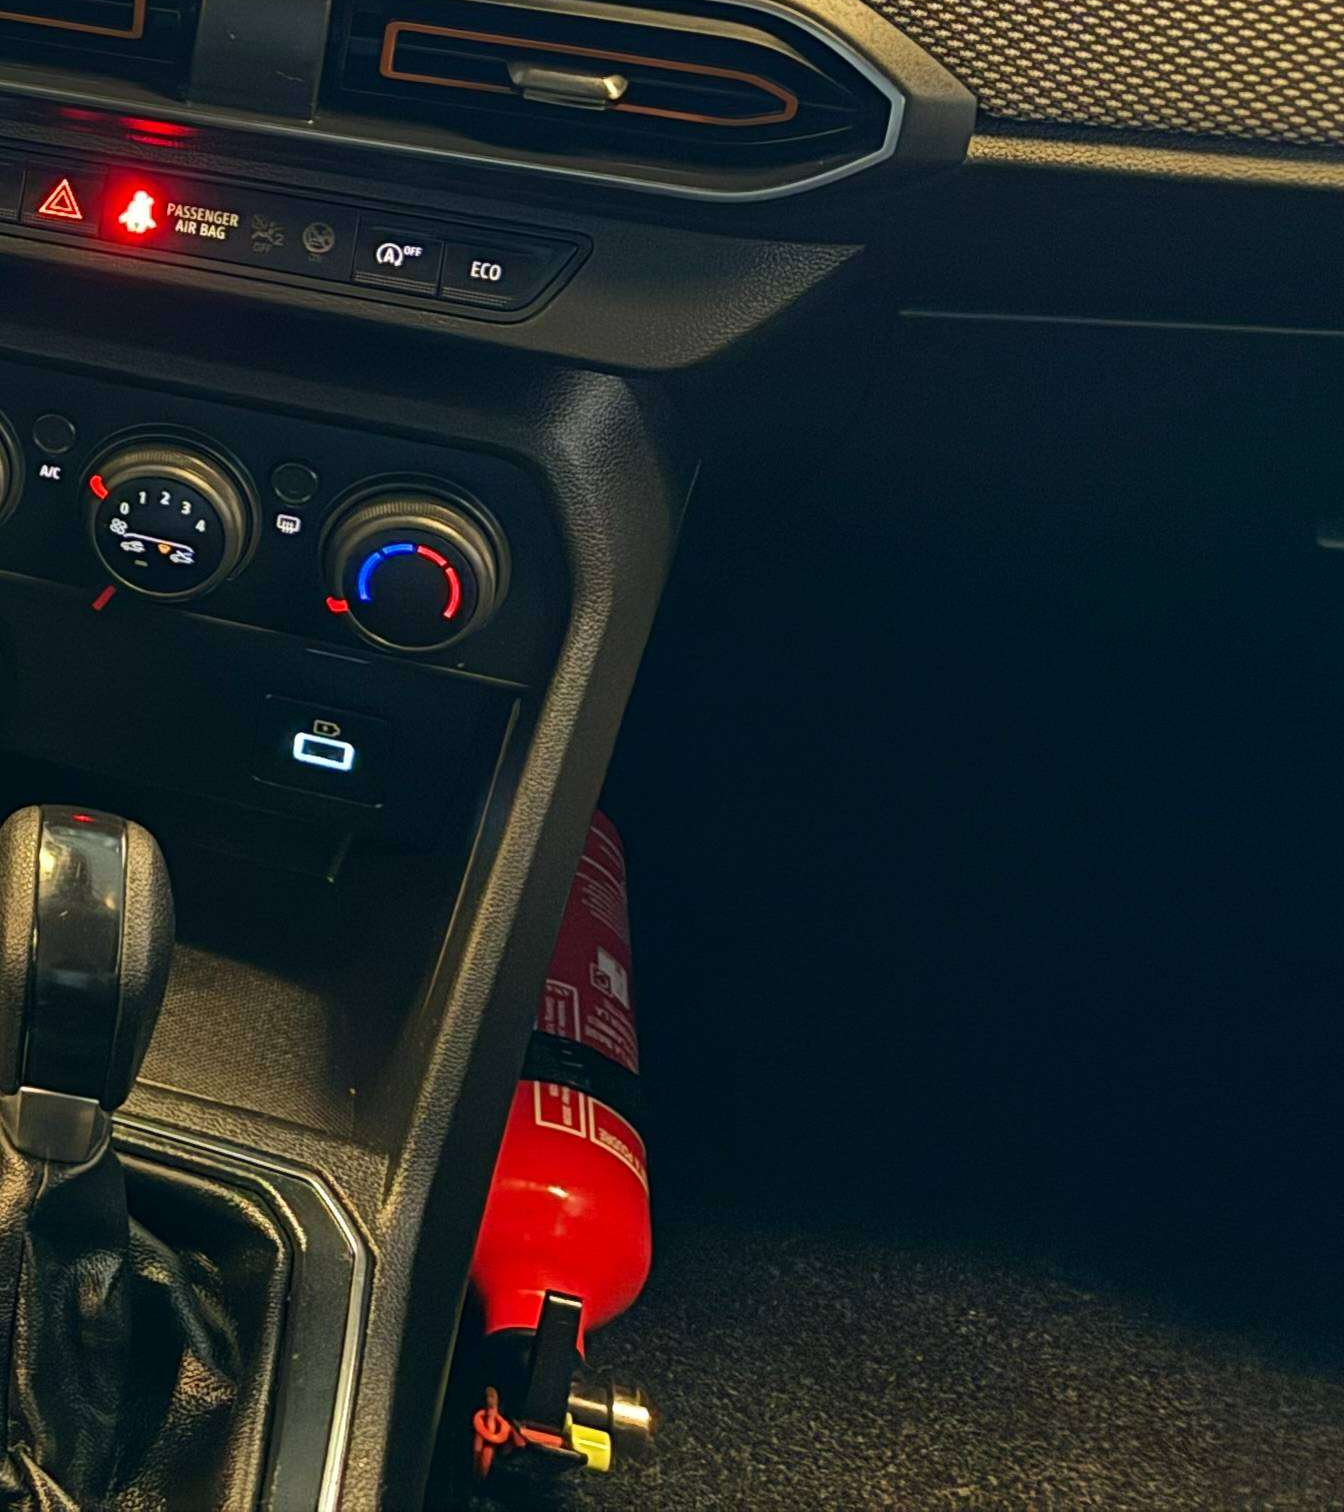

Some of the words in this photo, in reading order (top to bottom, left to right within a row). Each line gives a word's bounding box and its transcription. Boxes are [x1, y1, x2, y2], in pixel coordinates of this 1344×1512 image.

[166, 202, 240, 228] PASSENGER
[175, 219, 196, 235] AIR
[199, 224, 226, 240] BAG
[403, 245, 424, 257] OFF
[470, 261, 502, 281] ECO
[40, 464, 61, 480] A/C
[139, 491, 146, 504] 1
[160, 491, 170, 505] 2
[120, 502, 130, 515] 0
[181, 501, 192, 515] 3
[195, 519, 206, 533] 4
